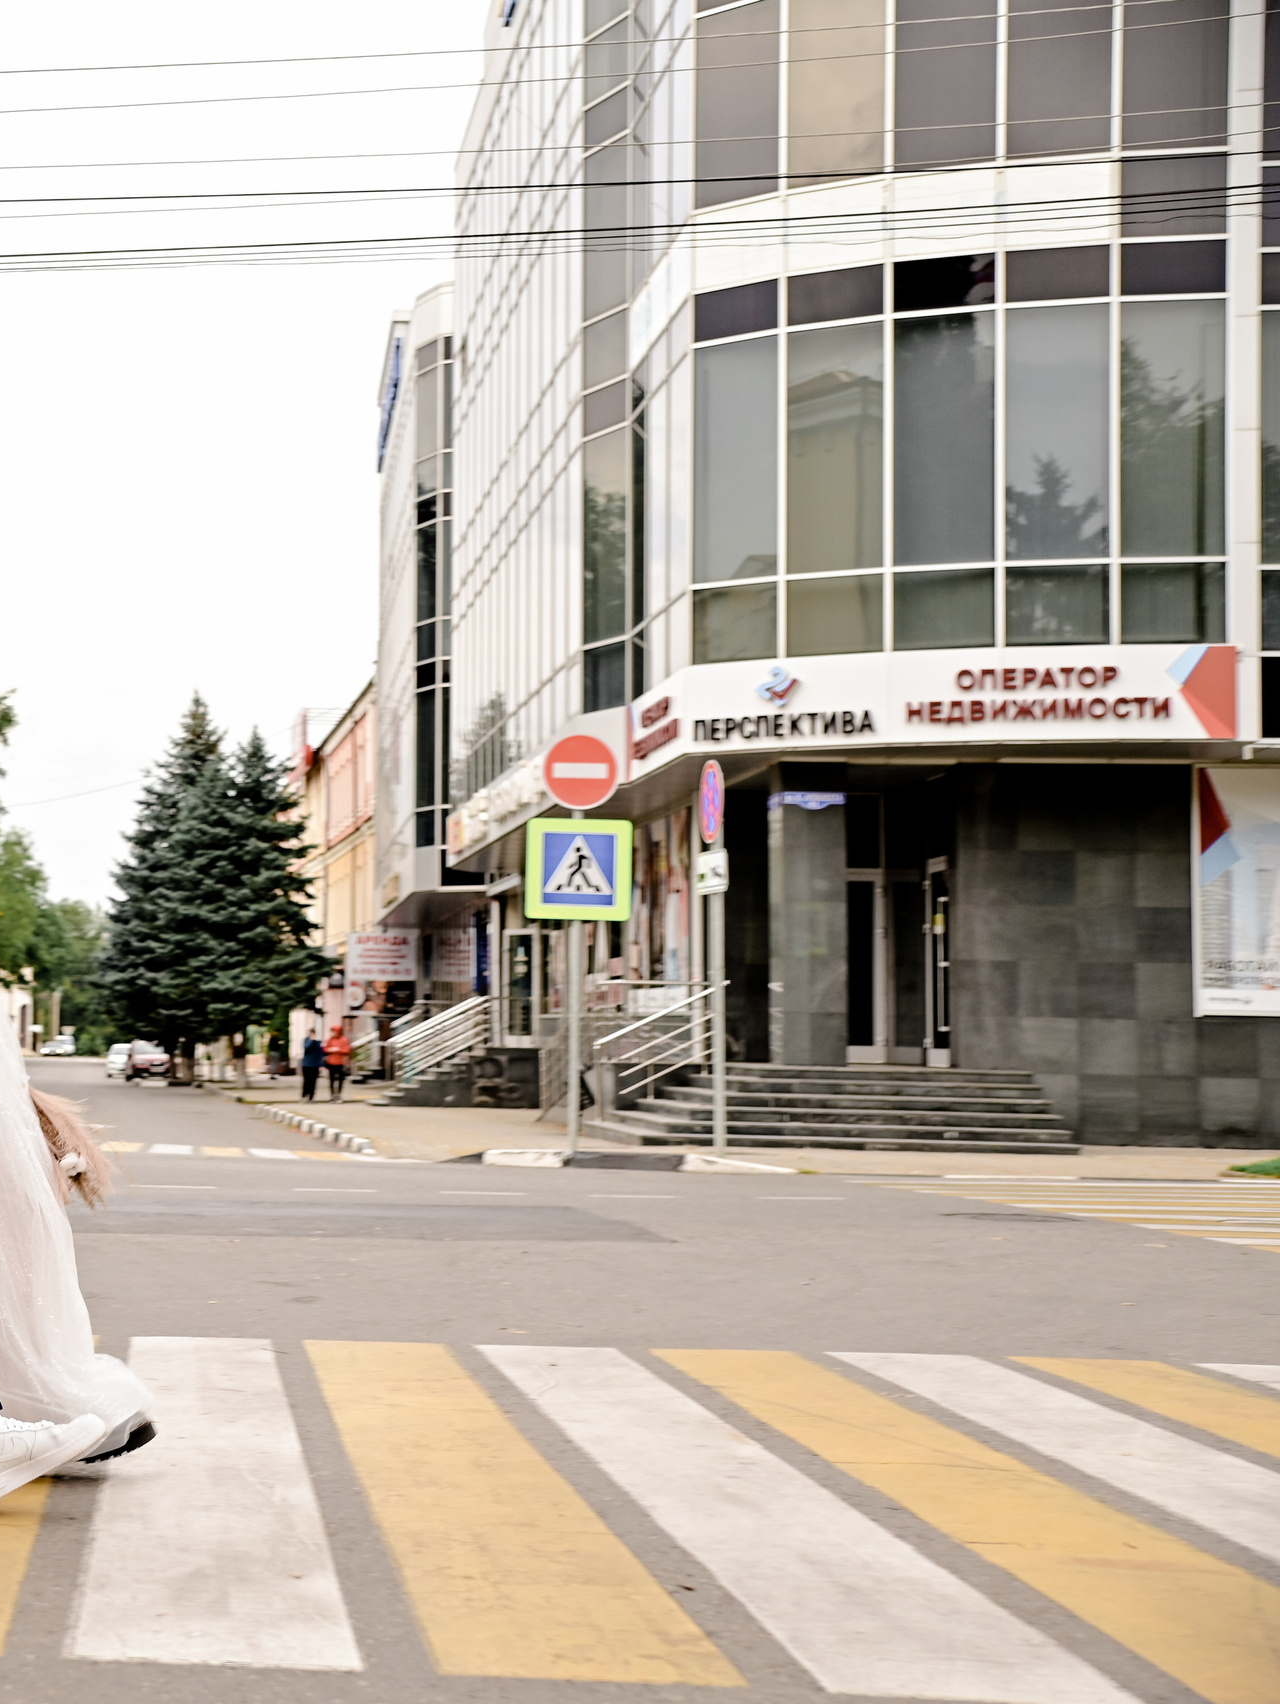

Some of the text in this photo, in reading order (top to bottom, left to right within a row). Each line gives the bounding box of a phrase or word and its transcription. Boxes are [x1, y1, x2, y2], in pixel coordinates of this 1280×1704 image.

[957, 666, 1117, 690] ОПЕРАТОР
[907, 697, 1171, 724] НЕДВИЖИМОСТИ
[694, 710, 875, 742] ПЕРСПЕКТИВА
